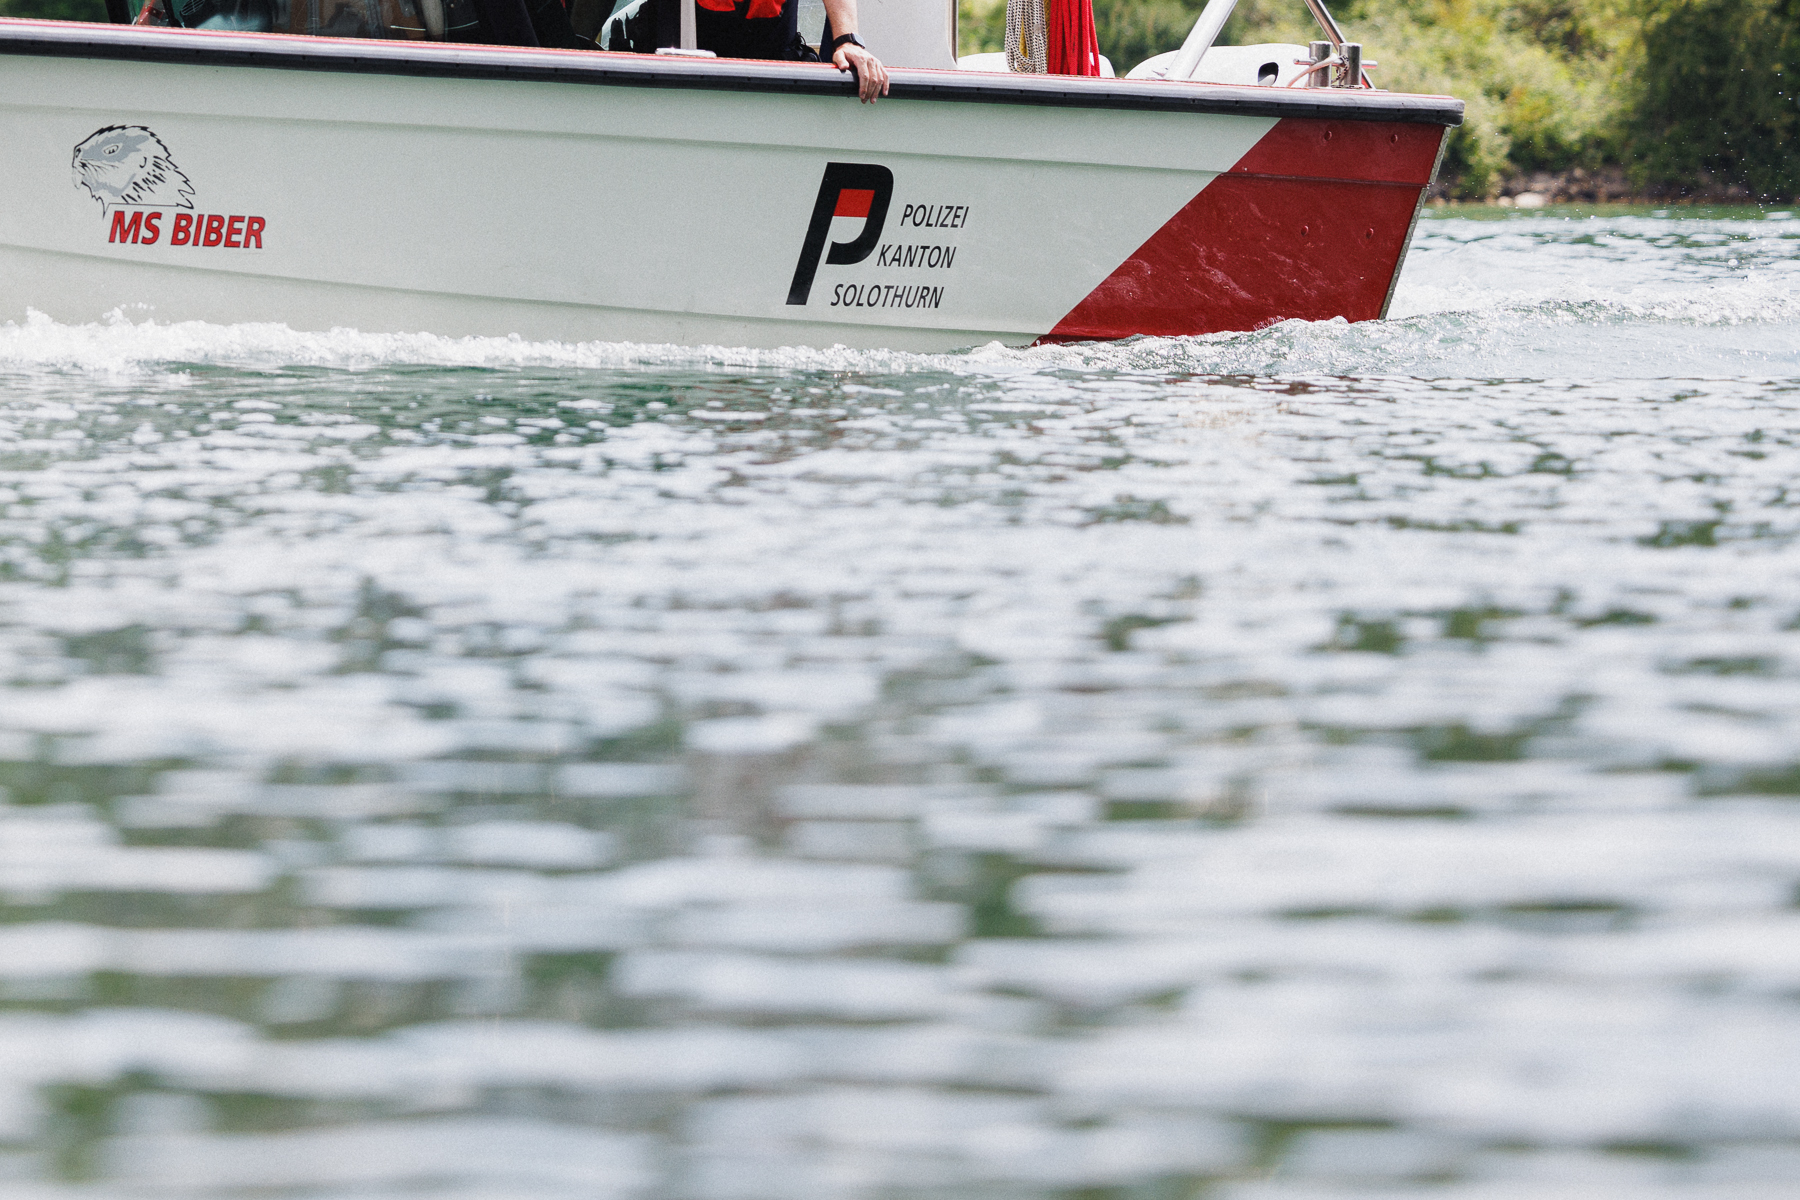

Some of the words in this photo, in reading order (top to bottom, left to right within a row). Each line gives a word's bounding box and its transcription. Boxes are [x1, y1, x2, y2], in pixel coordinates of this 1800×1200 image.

[900, 203, 969, 228] POLIZEI
[108, 210, 163, 245] MS
[170, 213, 266, 249] BIBER
[876, 244, 957, 269] KANTON
[830, 283, 945, 308] SOLOTHURN
